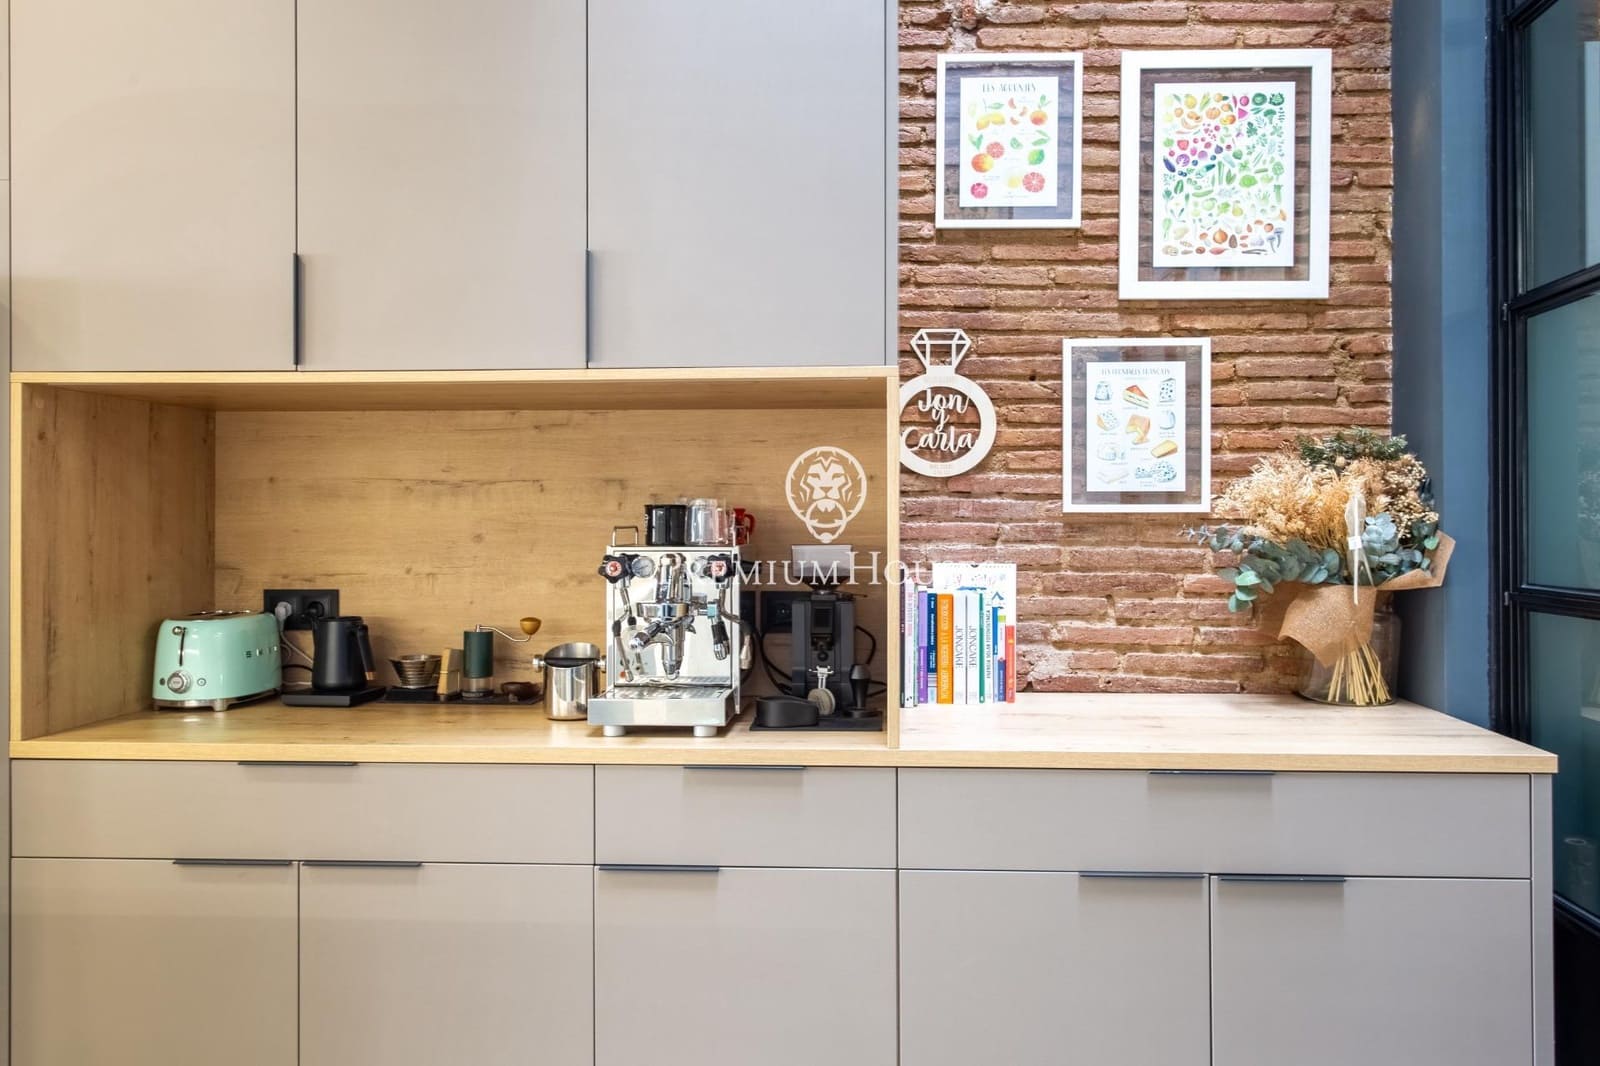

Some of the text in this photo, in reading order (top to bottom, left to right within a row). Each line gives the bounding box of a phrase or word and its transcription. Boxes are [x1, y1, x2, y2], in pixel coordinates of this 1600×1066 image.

[918, 389, 969, 413] Jon
[931, 407, 950, 431] y
[901, 426, 978, 454] Carla
